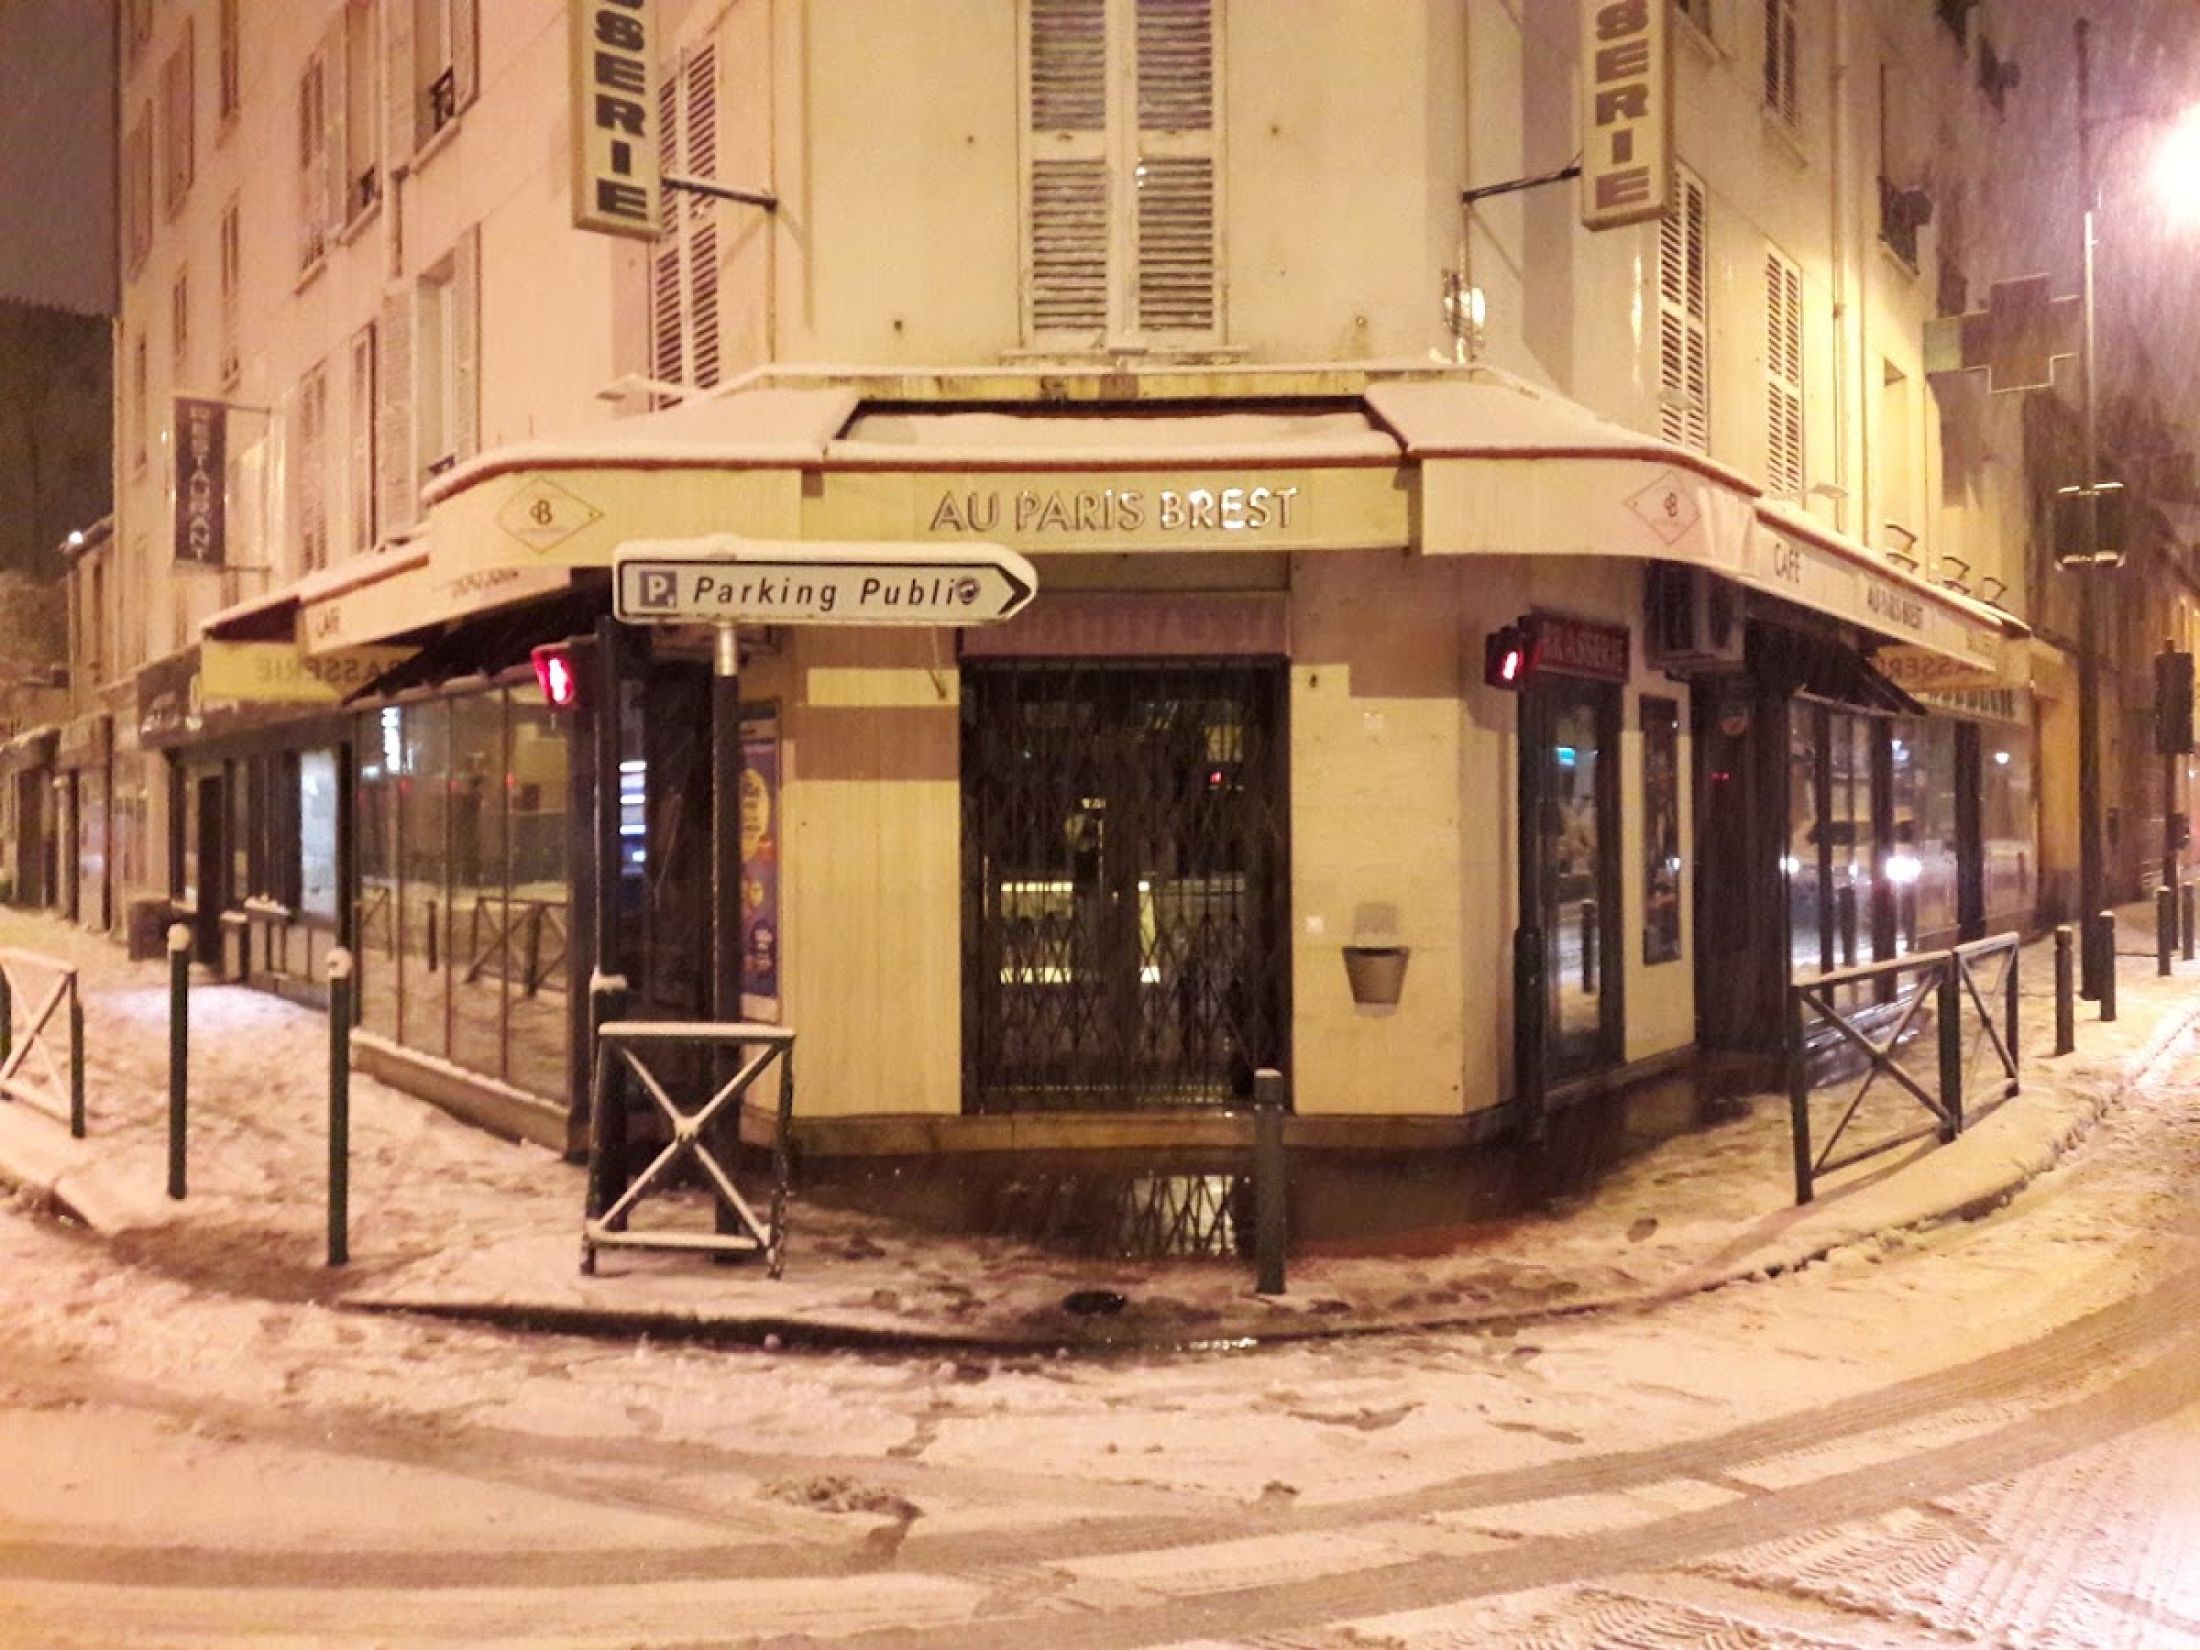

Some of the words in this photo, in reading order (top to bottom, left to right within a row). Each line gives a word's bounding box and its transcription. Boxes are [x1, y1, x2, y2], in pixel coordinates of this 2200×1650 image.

[594, 0, 648, 220] SERIE
[928, 489, 1000, 532] AU
[1014, 488, 1146, 532] PARIS
[1160, 486, 1299, 532] BREST
[692, 575, 838, 612] Parking
